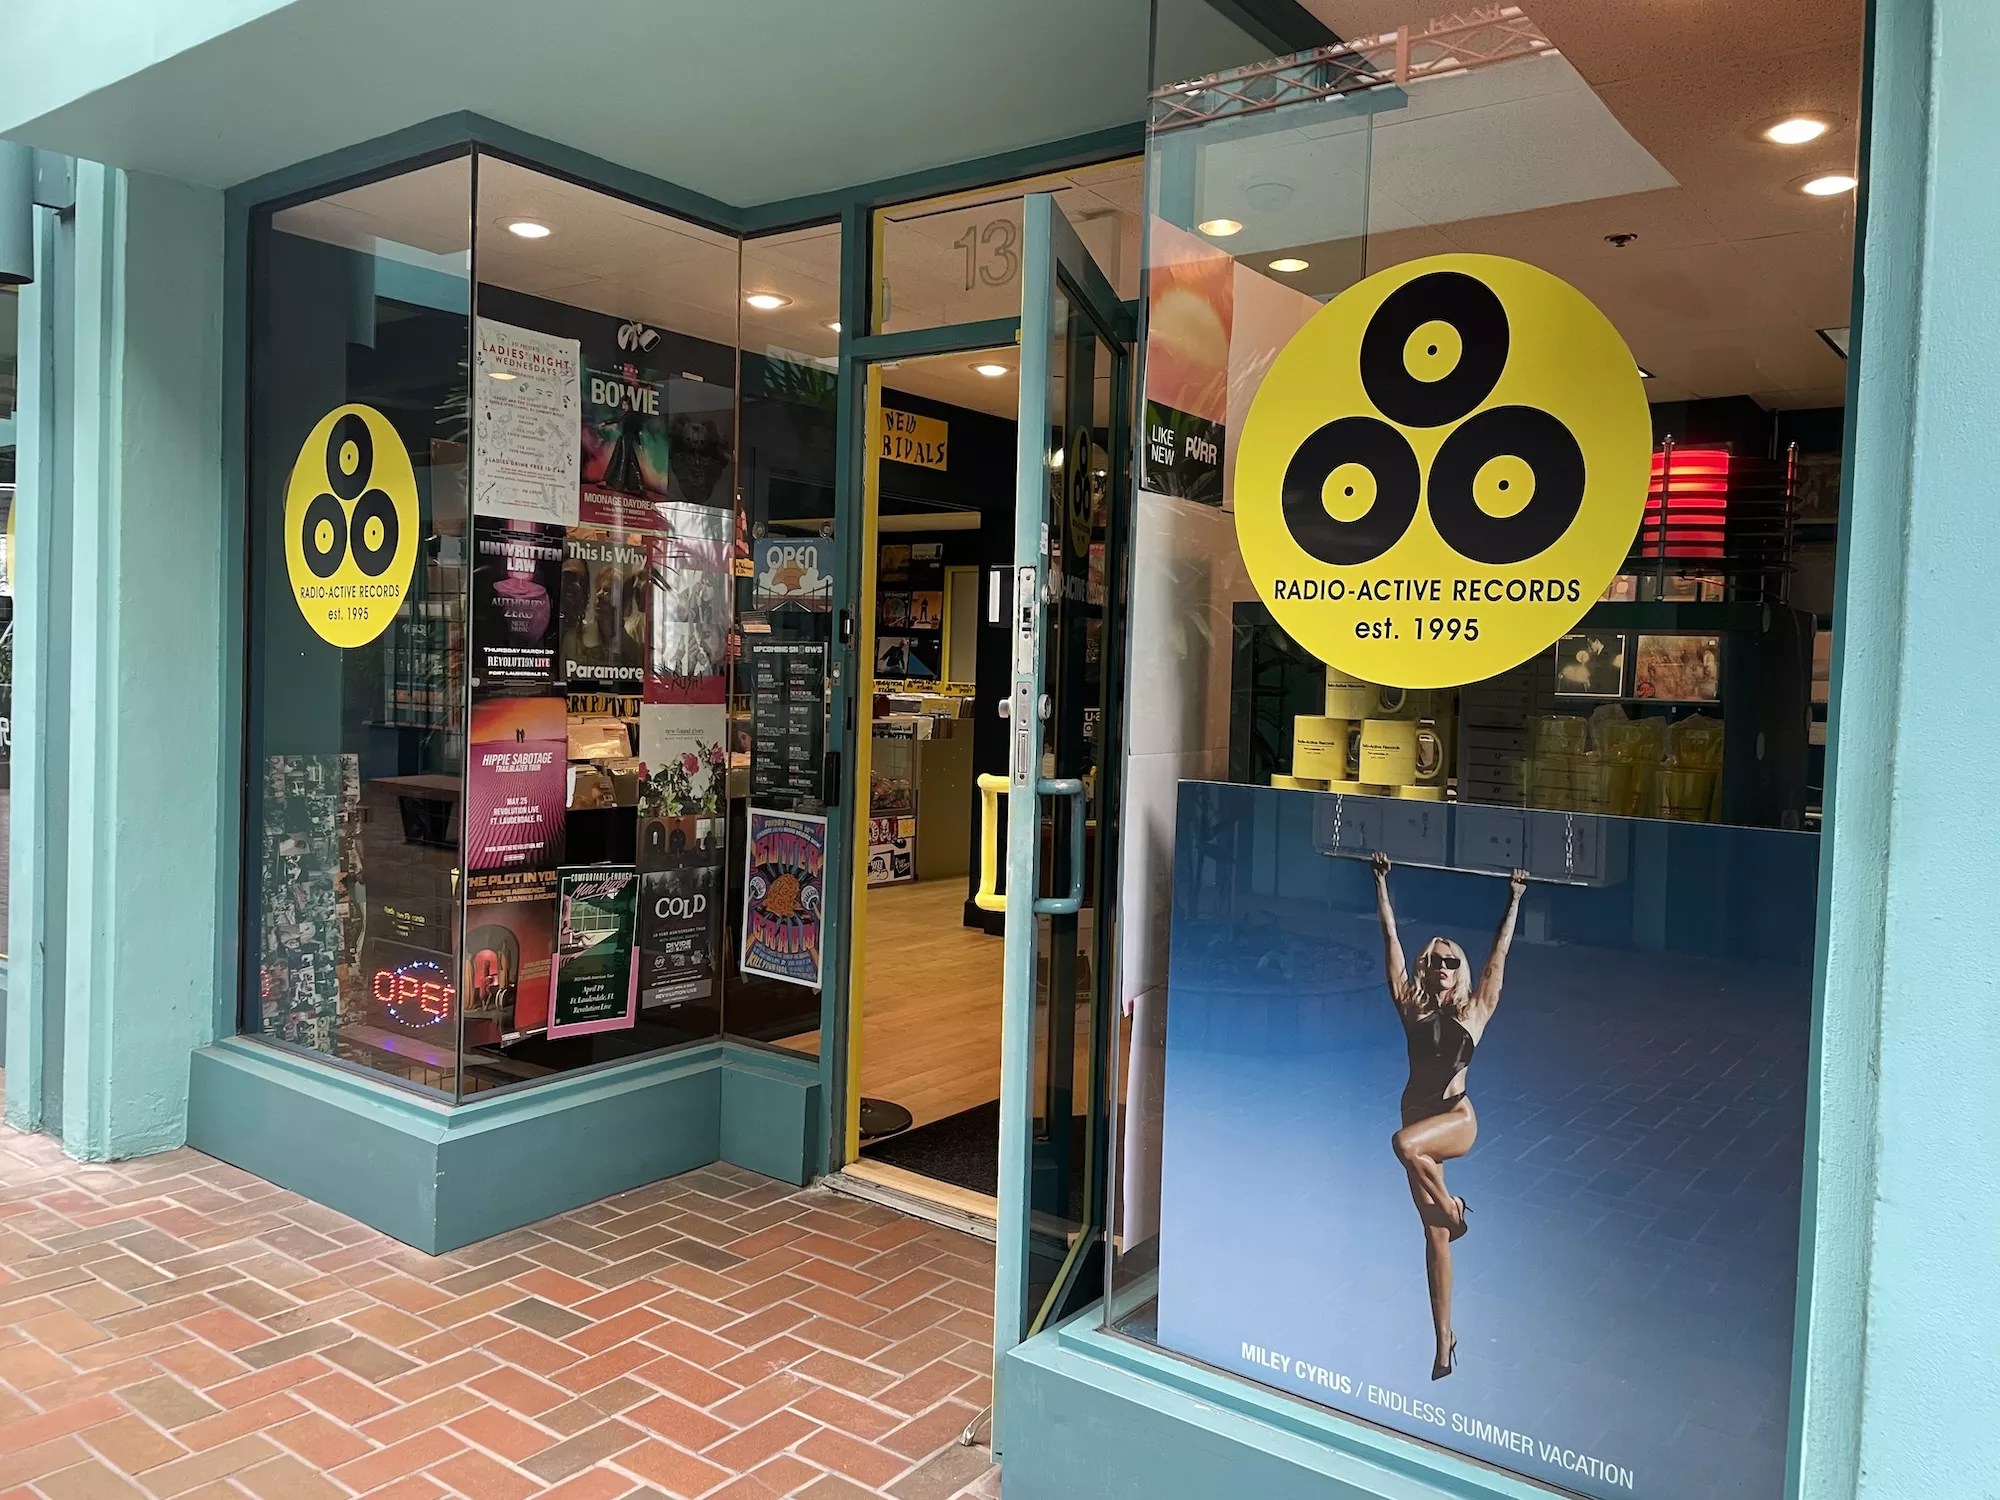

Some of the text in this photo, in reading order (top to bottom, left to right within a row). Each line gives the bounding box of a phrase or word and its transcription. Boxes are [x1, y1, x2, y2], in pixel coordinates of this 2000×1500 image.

[953, 218, 1018, 291] 13
[495, 356, 557, 376] WEDNESDAYS
[533, 353, 570, 370] NIGHT
[591, 377, 660, 416] BOWIE
[885, 411, 917, 434] NEW
[1152, 424, 1175, 447] LIKE
[1151, 443, 1175, 466] NEW
[1185, 435, 1217, 465] PURR
[584, 492, 622, 507] MOONAGE
[623, 497, 656, 512] DAYDREA
[479, 540, 563, 562] UNWRITTEN
[567, 542, 647, 569] This Is Why
[767, 546, 818, 569] OPEN
[507, 558, 536, 573] LAW
[300, 584, 400, 600] RADIO-ACTIVE RECORDS
[1273, 578, 1581, 602] RADIO-ACTIVE RECORDS
[328, 607, 369, 621] est. 1995
[504, 608, 533, 619] ZERO
[1355, 617, 1480, 641] est. 1995
[753, 645, 788, 653] UPCOMING
[487, 656, 550, 668] REVOLUTION LIVE
[565, 660, 644, 681] Paramore
[482, 752, 553, 766] HIPPIE SABOTAGE
[529, 763, 542, 772] TOUR
[507, 797, 519, 805] MAY
[493, 805, 539, 816] REVOLUTION LIVE
[536, 815, 543, 823] FL
[755, 831, 823, 877] BUTTER
[488, 873, 523, 886] PLOT
[523, 872, 538, 883] IN
[570, 872, 609, 882] COMFORTABLE
[476, 888, 511, 898] HOLDING
[533, 892, 557, 901] ARCAD
[571, 883, 598, 899] Mac
[655, 894, 707, 919] COLD
[753, 911, 816, 954] BRAIN
[665, 939, 692, 949] DIVIDE
[582, 984, 597, 995] April
[655, 988, 687, 999] REVOLUTION
[573, 1002, 612, 1014] Revolution Live
[1241, 1341, 1634, 1491] MILEY CYRUS / ENDLESS SUMMER VACATION
